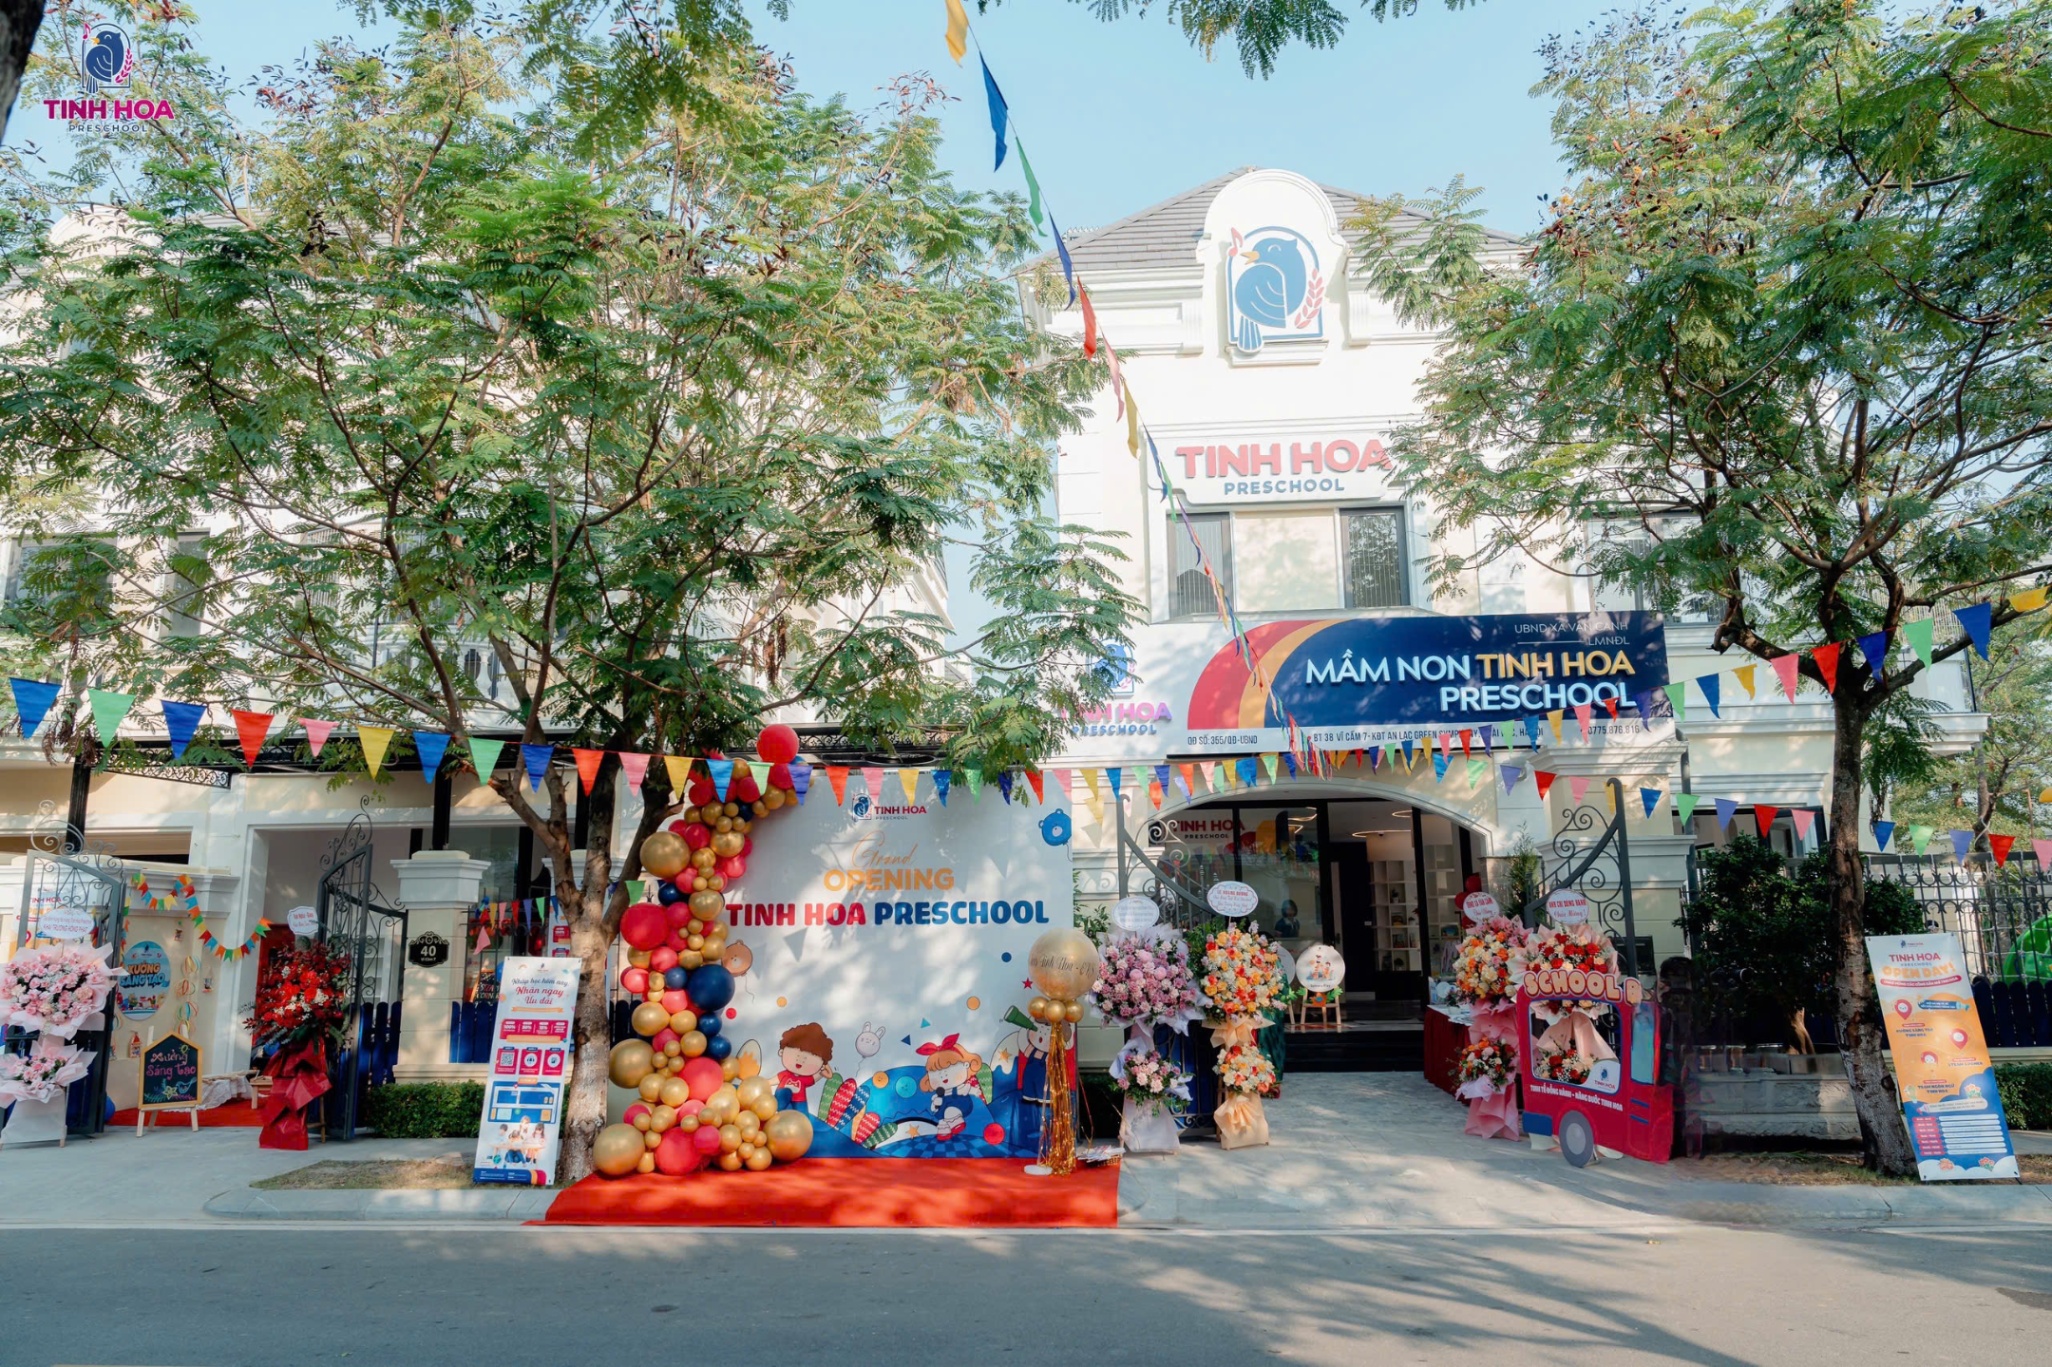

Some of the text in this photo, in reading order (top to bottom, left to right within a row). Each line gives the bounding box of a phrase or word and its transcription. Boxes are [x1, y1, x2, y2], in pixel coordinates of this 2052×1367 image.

[1176, 439, 1394, 478] TINH HOA
[1224, 478, 1345, 496] PRESCHOOL
[1514, 623, 1548, 634] UBND
[1305, 648, 1636, 686] MẦM NON TINH HOA
[1440, 681, 1638, 712] PRESCHOOL
[1117, 702, 1173, 721] HOA
[1072, 724, 1158, 736] PRESCHOOL
[1313, 733, 1323, 742] BT
[1324, 733, 1334, 741] 38
[1387, 731, 1398, 740] AN
[1414, 729, 1437, 740] GREEN
[874, 805, 927, 815] TINH HOA
[852, 830, 918, 868] Grand
[823, 868, 955, 891] OPENING
[726, 900, 1050, 927] TINH HOA PRESCHOOL
[420, 945, 437, 957] 40
[1889, 952, 1941, 963] TINH HOA
[1882, 960, 1956, 979] OPEN DAY!
[1523, 969, 1623, 1002] SCHOOL
